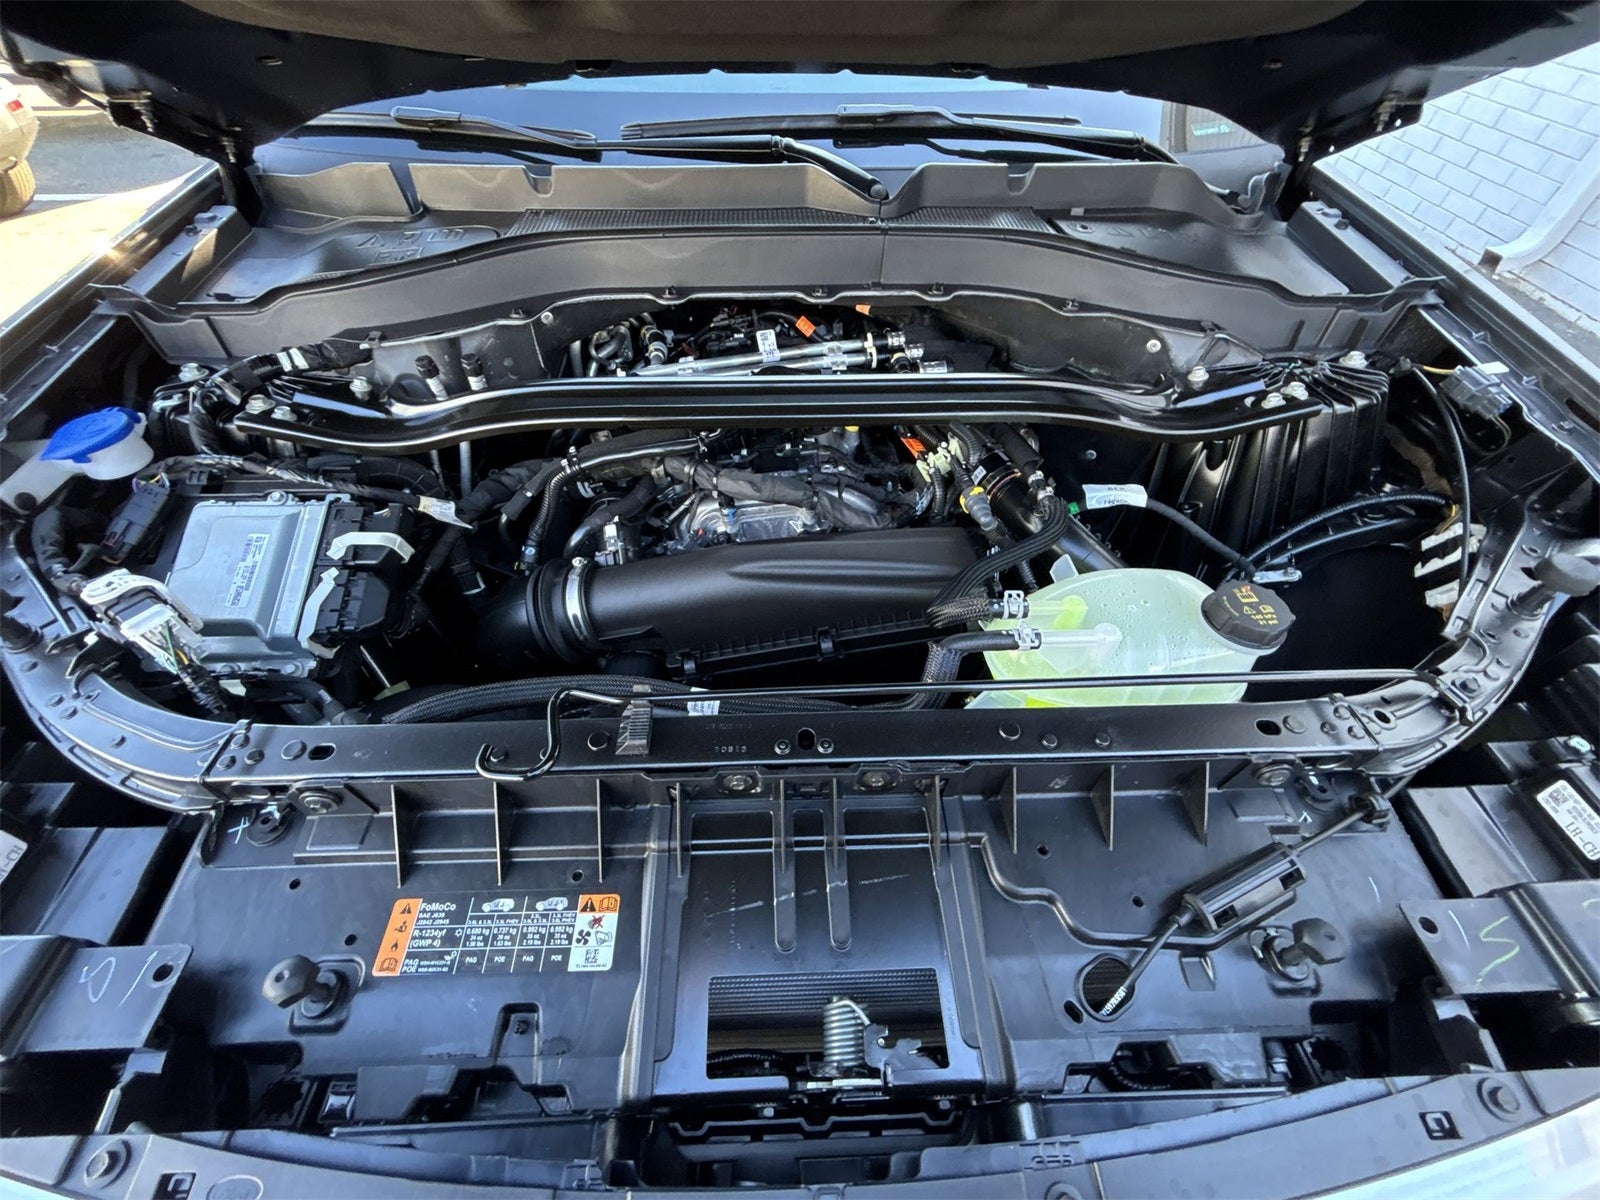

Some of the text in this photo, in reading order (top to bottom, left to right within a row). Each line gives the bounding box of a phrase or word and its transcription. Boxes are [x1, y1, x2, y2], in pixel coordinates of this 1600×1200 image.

[420, 902, 456, 911] FoMoCo
[413, 929, 447, 938] R-1234yf
[410, 939, 441, 948] (GWP 4)
